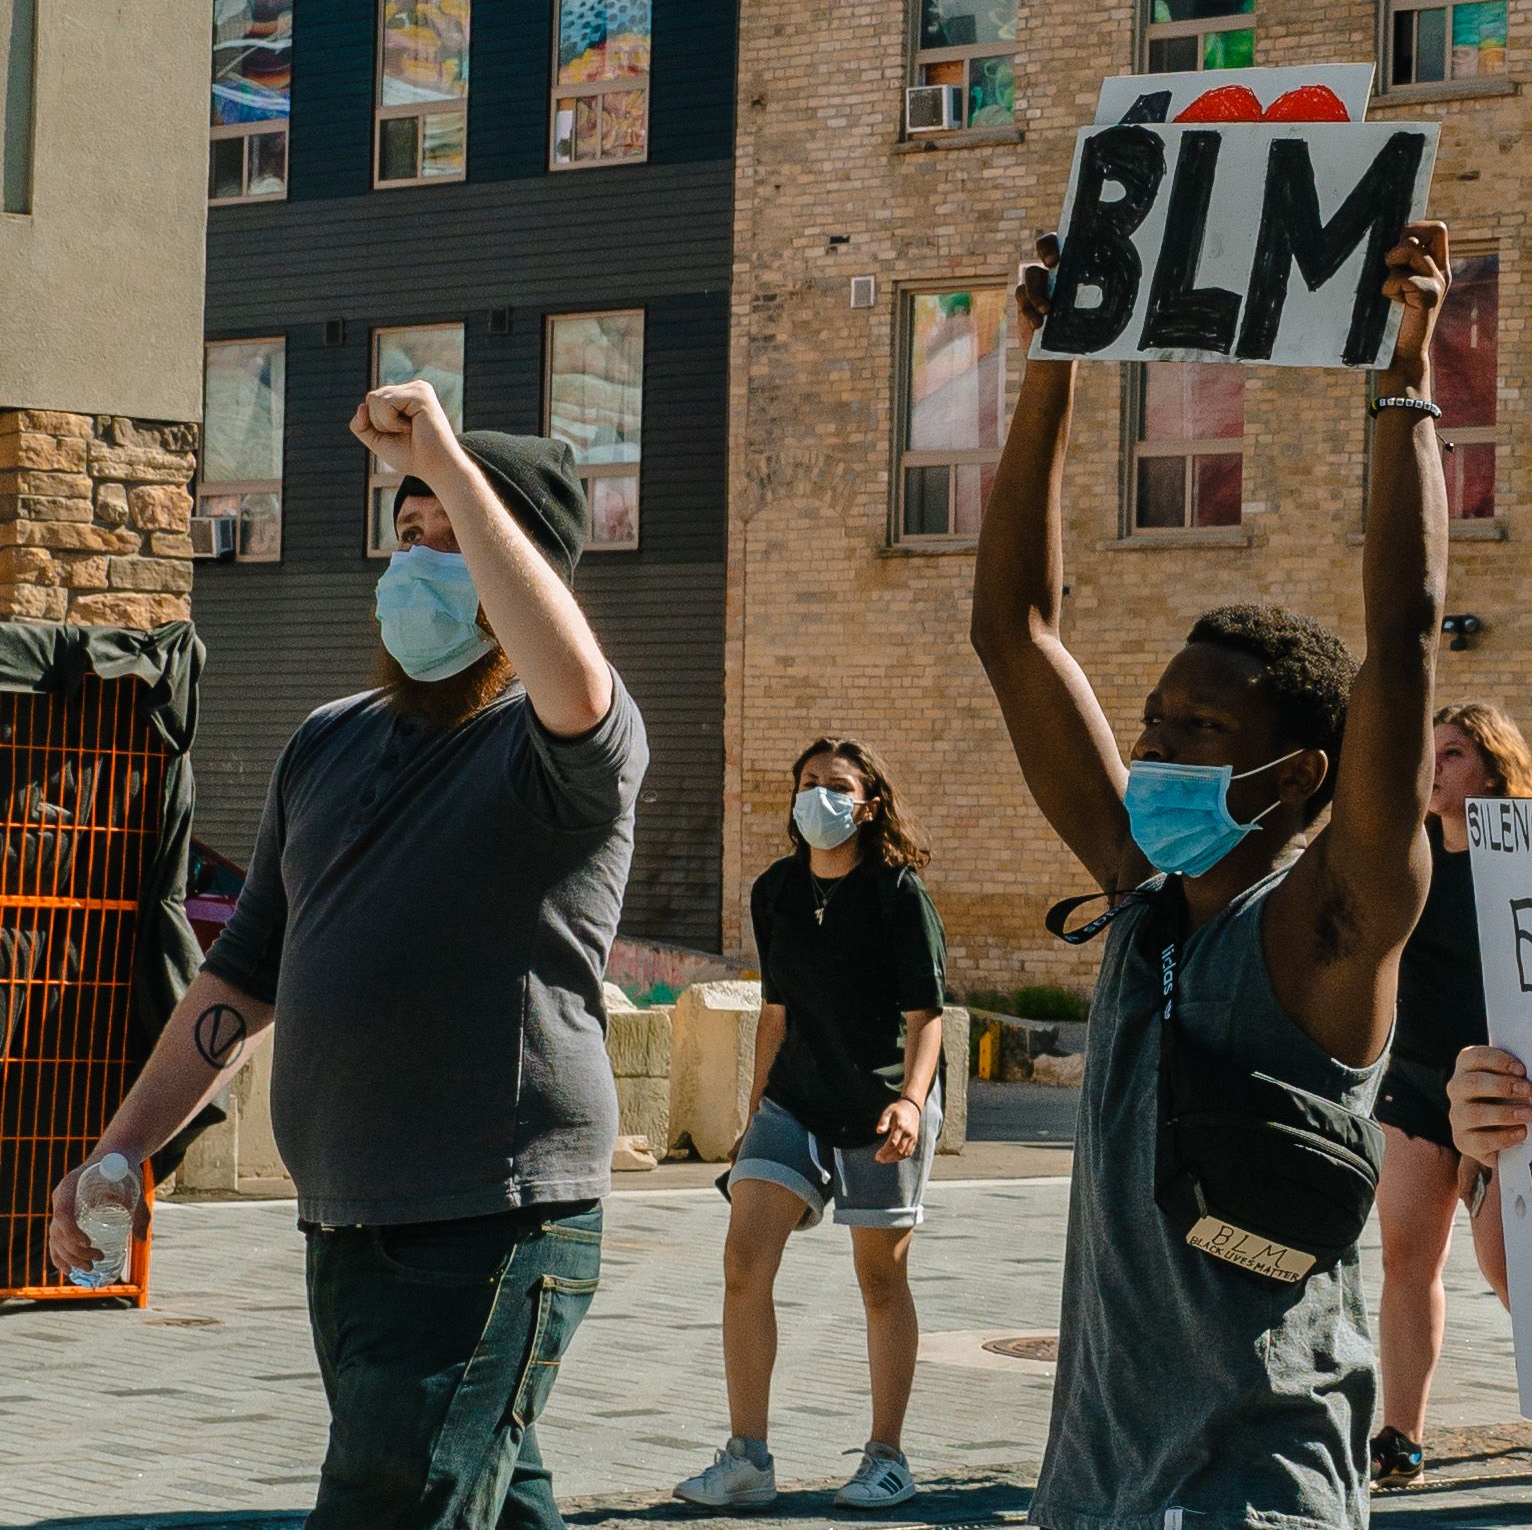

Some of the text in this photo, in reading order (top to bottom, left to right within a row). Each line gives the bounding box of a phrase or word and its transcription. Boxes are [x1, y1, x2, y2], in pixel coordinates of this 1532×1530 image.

[1040, 125, 1425, 365] BLM
[1189, 1235, 1300, 1281] BLACK LIVES MATTER
[1212, 1225, 1288, 1268] BLM
